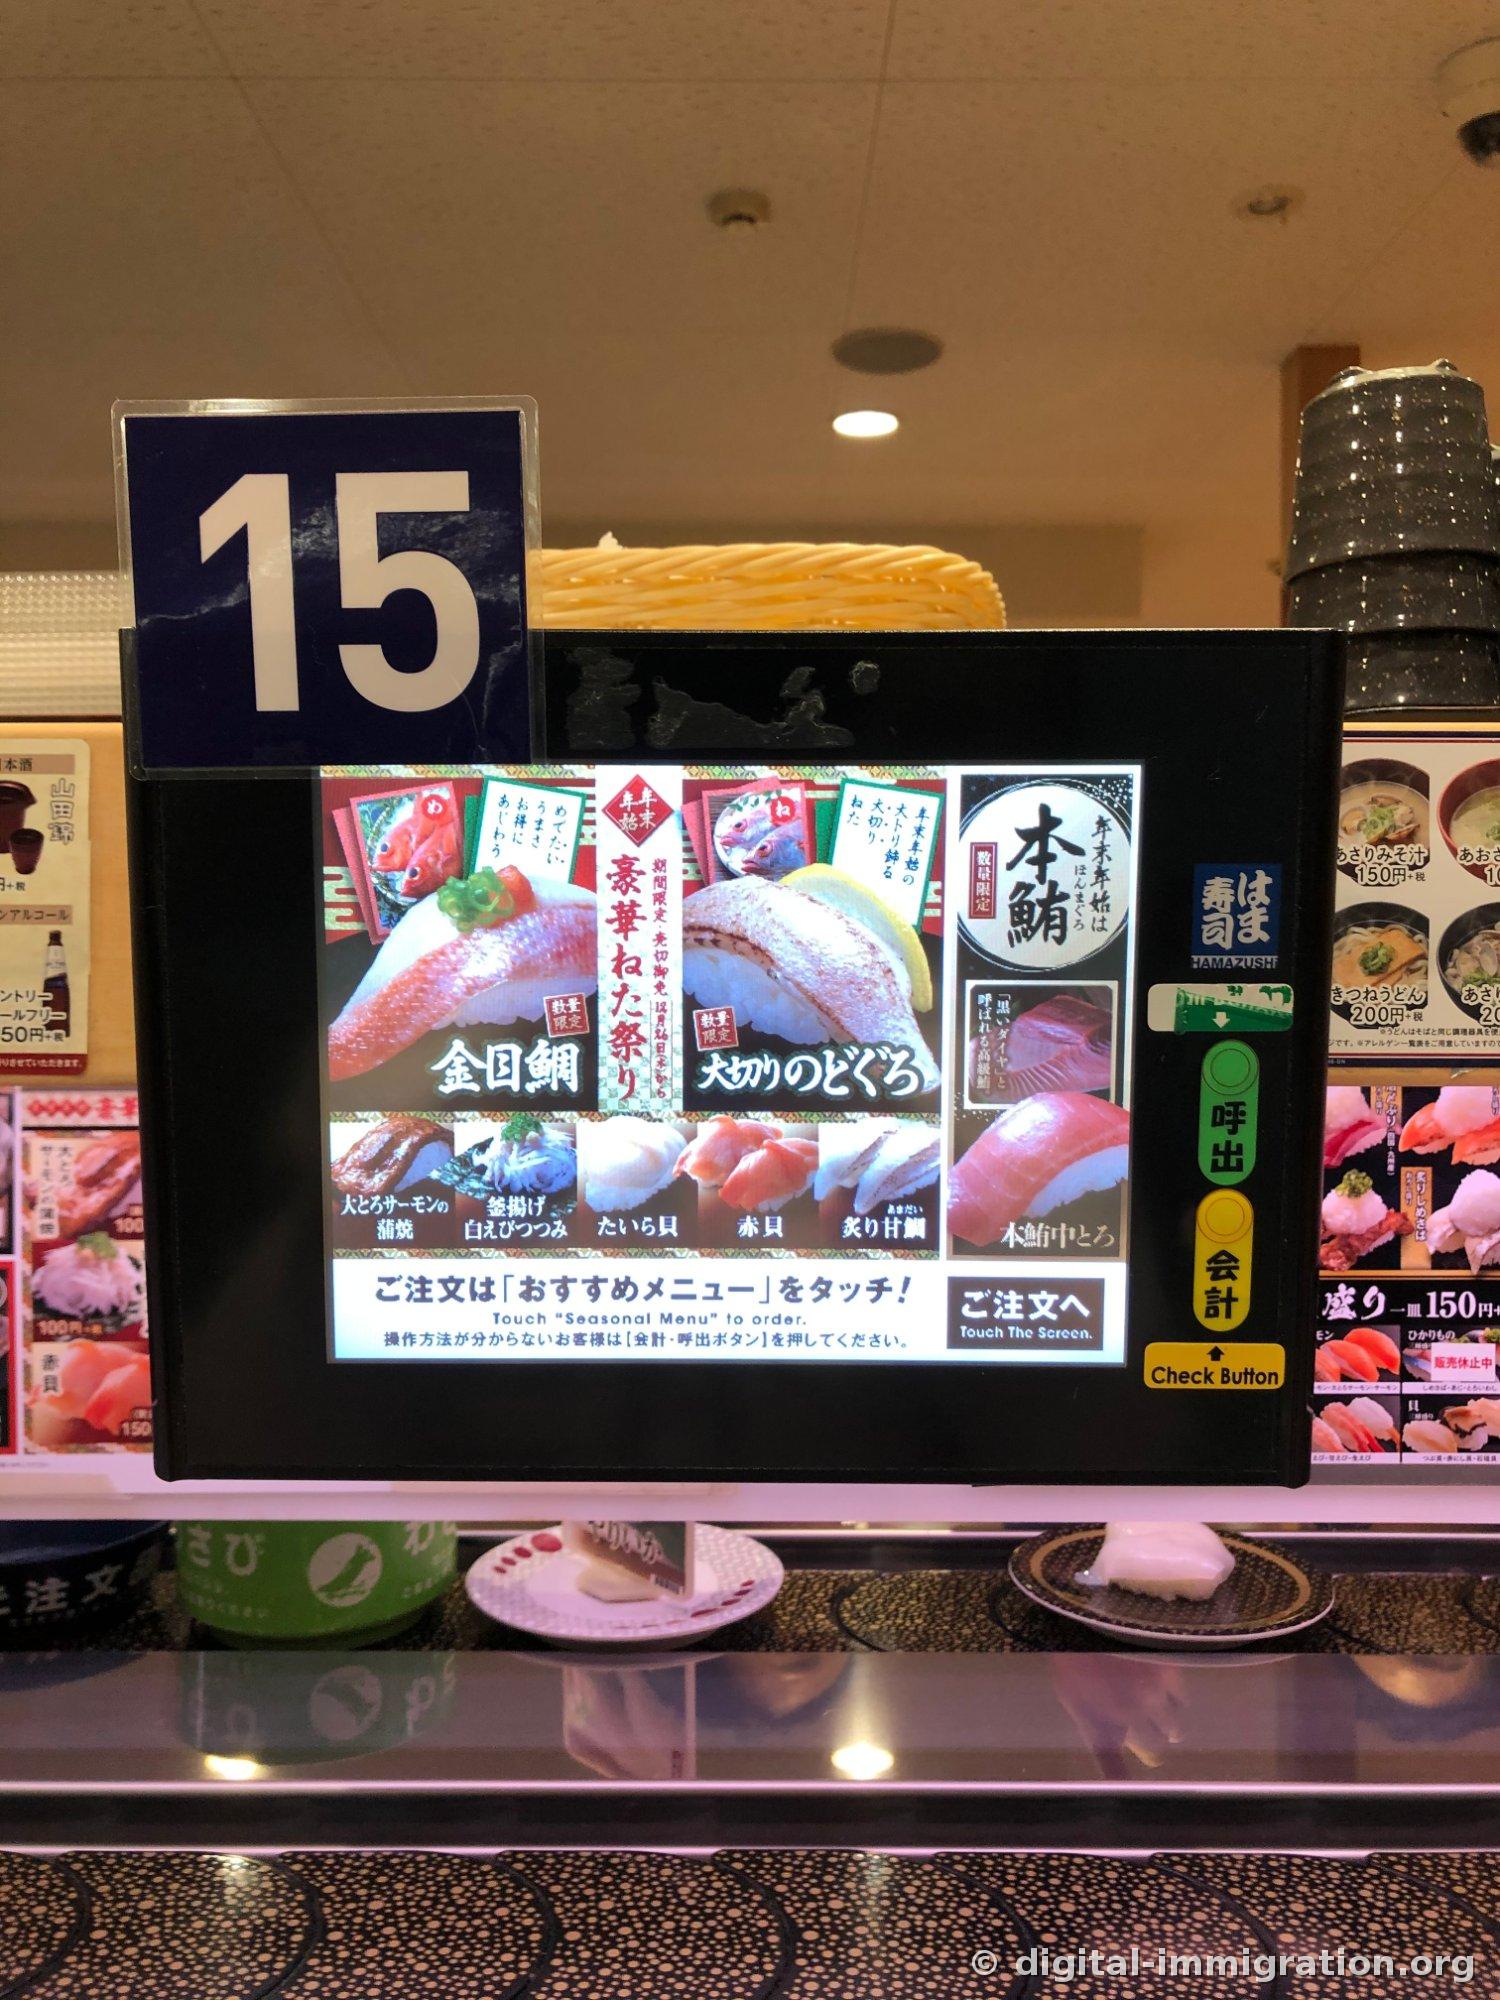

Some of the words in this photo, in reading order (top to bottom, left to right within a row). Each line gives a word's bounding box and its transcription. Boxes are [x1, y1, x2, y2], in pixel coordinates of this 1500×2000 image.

[200, 471, 480, 712] 15
[0, 758, 33, 772] 本酒
[513, 797, 529, 845] お得に
[776, 801, 791, 817] ね
[847, 794, 863, 826] ねた
[868, 798, 884, 845] 大切り
[492, 793, 510, 858] あじわう
[532, 801, 546, 848] うまさ
[903, 806, 930, 886] 年末年始の
[1337, 846, 1426, 862] あさりみそ汁
[976, 851, 992, 912] 数量限定
[1006, 803, 1086, 948] 本鮪
[1090, 815, 1112, 932] 年末年始は
[1074, 865, 1087, 932] ほんまぐろ
[1191, 955, 1278, 969] HAMAZUSHI
[606, 854, 648, 1101] 豪華ねた祭り
[1331, 986, 1423, 1002] きつねうどん
[430, 1040, 580, 1094] 金目鯛
[698, 1046, 919, 1097] 大切りのどぐろ
[1210, 1101, 1247, 1173] 呼出
[341, 1194, 449, 1216] 大とろサーモンの
[486, 1195, 546, 1218] 釜揚げ
[377, 1220, 414, 1240] 蒲焼
[464, 1220, 568, 1240] 白えびつつみ
[597, 1216, 678, 1238] たいら貝
[737, 1216, 784, 1238] 赤貝
[842, 1216, 926, 1239] 炙り甘鯛
[1001, 1222, 1114, 1249] 本鮪中とろ
[1204, 1249, 1240, 1320] 会計
[493, 1312, 546, 1325] Touch
[726, 1312, 744, 1325] to
[752, 1312, 807, 1325] order.
[961, 1290, 1091, 1321] ご注文へ
[960, 1325, 1003, 1339] Touch
[1008, 1325, 1033, 1339] The
[1038, 1326, 1093, 1340] Screen.
[1408, 1329, 1456, 1341] ひかりもの
[1152, 1367, 1213, 1385] Check
[1221, 1367, 1278, 1385] Button
[1434, 1356, 1493, 1370] 販売休止中
